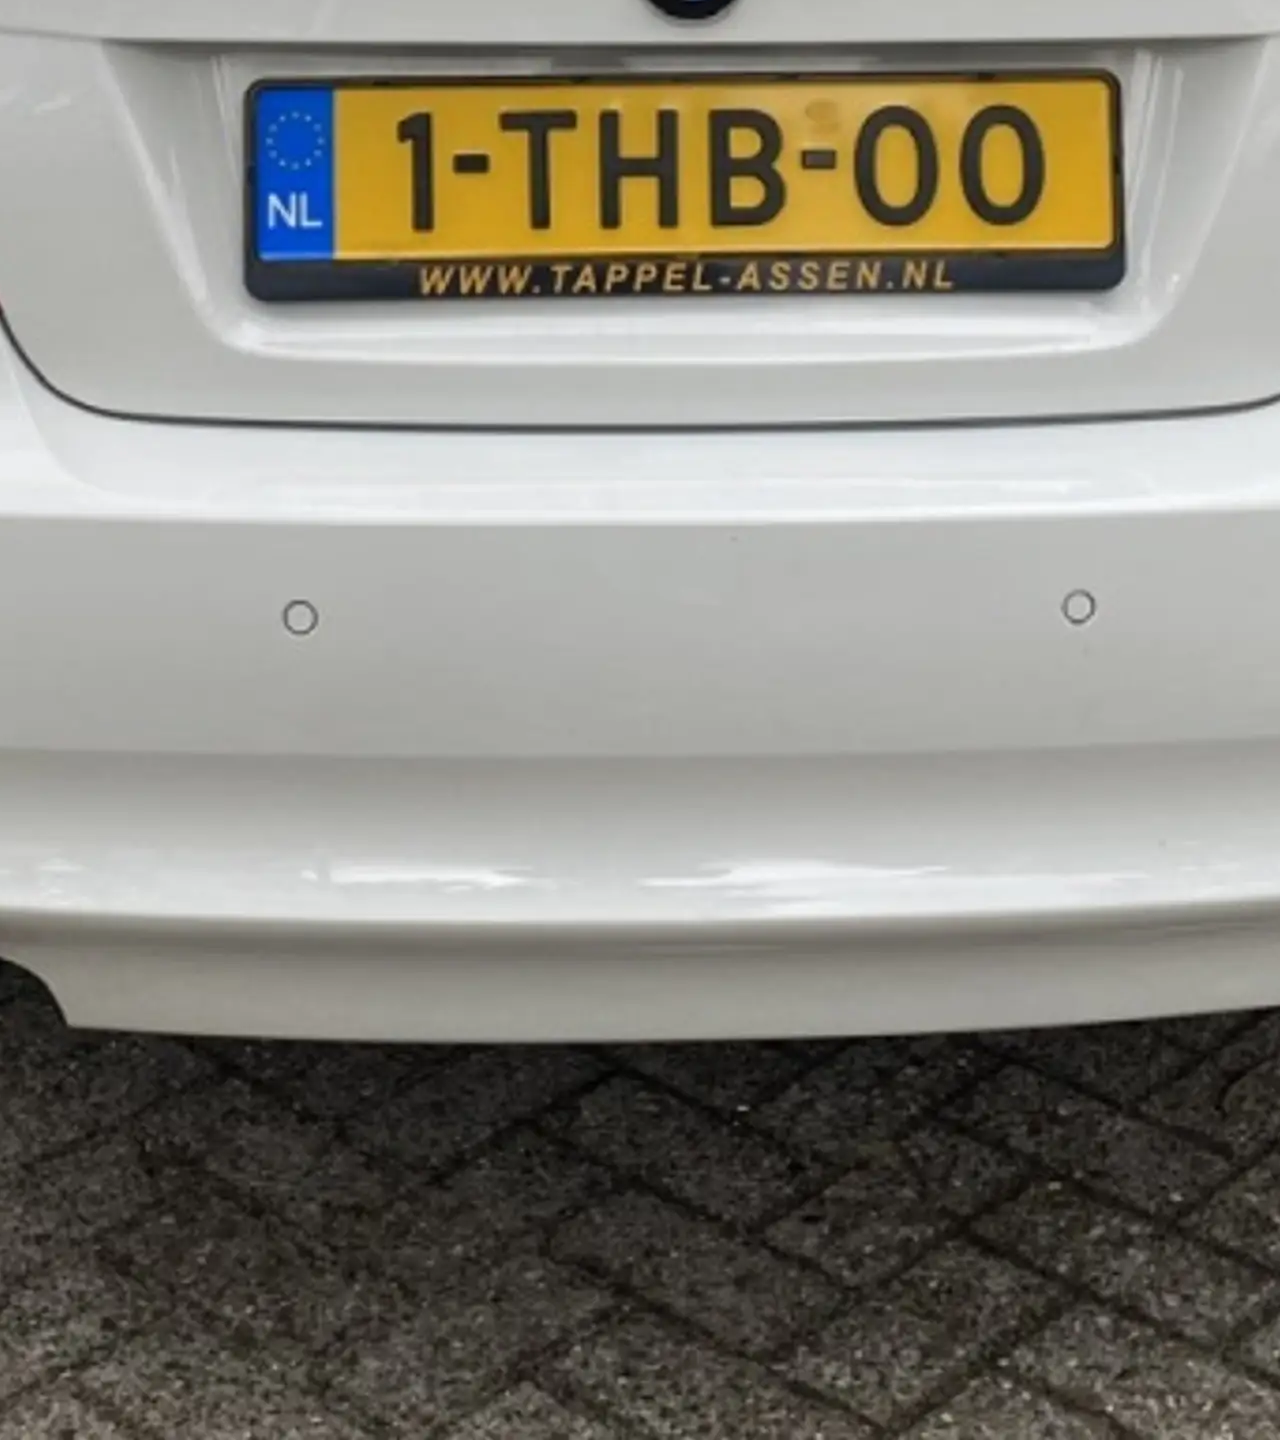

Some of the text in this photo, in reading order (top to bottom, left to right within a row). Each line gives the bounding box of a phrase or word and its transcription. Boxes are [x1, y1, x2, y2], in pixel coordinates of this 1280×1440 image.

[395, 103, 1047, 233] 1-THB-00
[268, 192, 324, 230] NL
[420, 261, 956, 295] WWW.TAPPEL-ASSEN.NL
